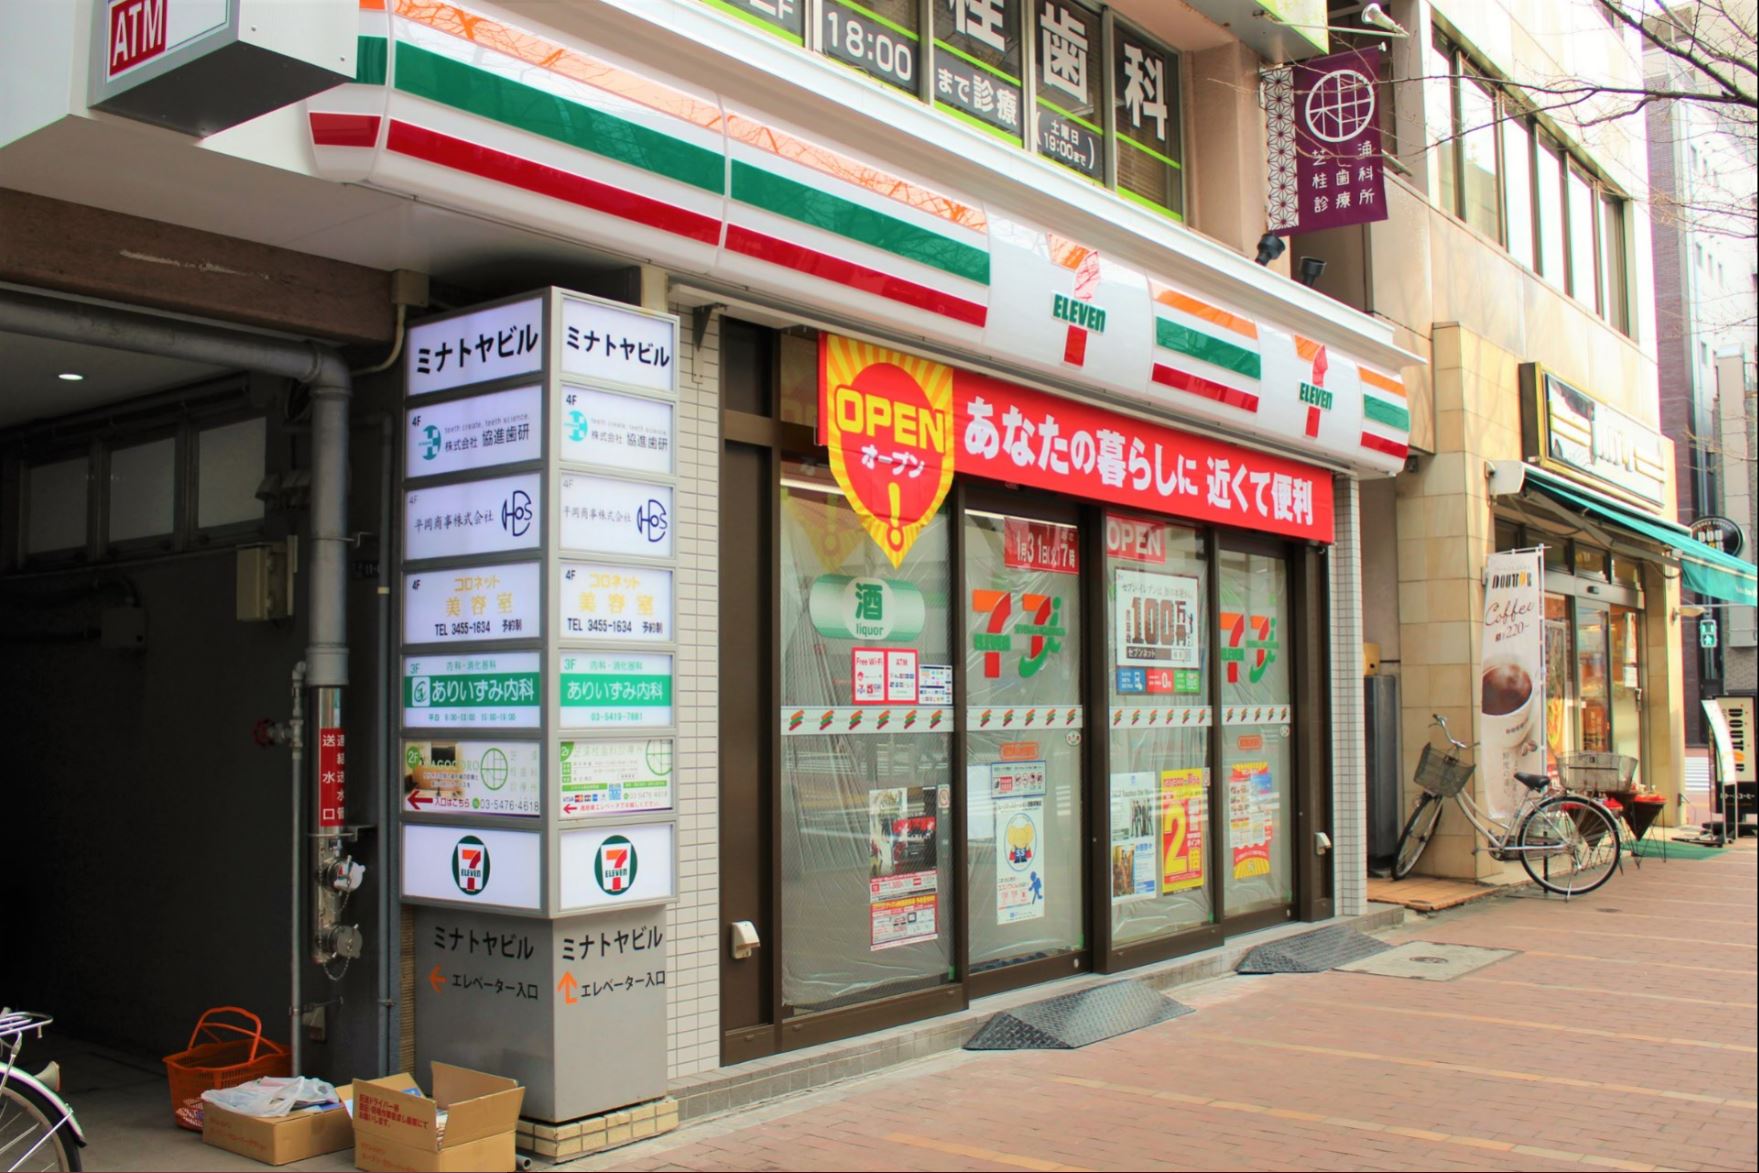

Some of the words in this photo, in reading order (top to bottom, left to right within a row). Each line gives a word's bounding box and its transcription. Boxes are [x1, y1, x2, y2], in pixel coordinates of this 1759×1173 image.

[112, 0, 163, 67] ATM
[827, 11, 912, 82] 18:00
[937, 67, 1017, 126] まで診療
[1311, 166, 1374, 190] 桂歯科
[1313, 189, 1376, 213] 診療所
[1052, 292, 1107, 334] ELEVEN
[416, 323, 540, 375] ミナトヤビル
[565, 325, 671, 368] ミナトヤビル
[566, 394, 577, 406] 4F
[1298, 381, 1333, 411] ELEVEN
[411, 415, 422, 427] 4F
[835, 386, 945, 454] OPEN
[445, 437, 478, 452] 株式会社
[482, 423, 530, 448] 協進歯研
[626, 432, 669, 451] 協進歯研
[861, 443, 925, 479] オープン
[964, 395, 1198, 498] あなたの暮らしに
[1206, 455, 1314, 526] 近くて便利
[1106, 522, 1161, 556] OPEN
[454, 575, 500, 592] コロネット
[565, 569, 576, 581] 4F
[446, 591, 513, 618] 美容室
[855, 582, 883, 621] 酒
[435, 623, 448, 636] TEL
[452, 621, 491, 635] 3455-1634
[567, 617, 583, 631] TEL
[587, 619, 632, 633] 3455-1634
[855, 623, 884, 637] liquor
[410, 663, 420, 674] 3F
[564, 658, 576, 670] 3F
[432, 677, 534, 702] ありいずみ内科
[567, 680, 664, 702] ありいずみ内科
[407, 750, 419, 764] 2F
[322, 733, 336, 820] 送水口
[434, 796, 470, 809] 入口はこちら
[480, 798, 540, 812] 03-5476-4618
[460, 867, 482, 878] ELEVEN
[604, 867, 628, 878] ELEVEN
[433, 926, 534, 960] ミナトヤビル
[562, 925, 664, 962] ミナトヤビル
[451, 974, 539, 1000] エレベーター入口
[581, 970, 666, 998] エレベーター入口
